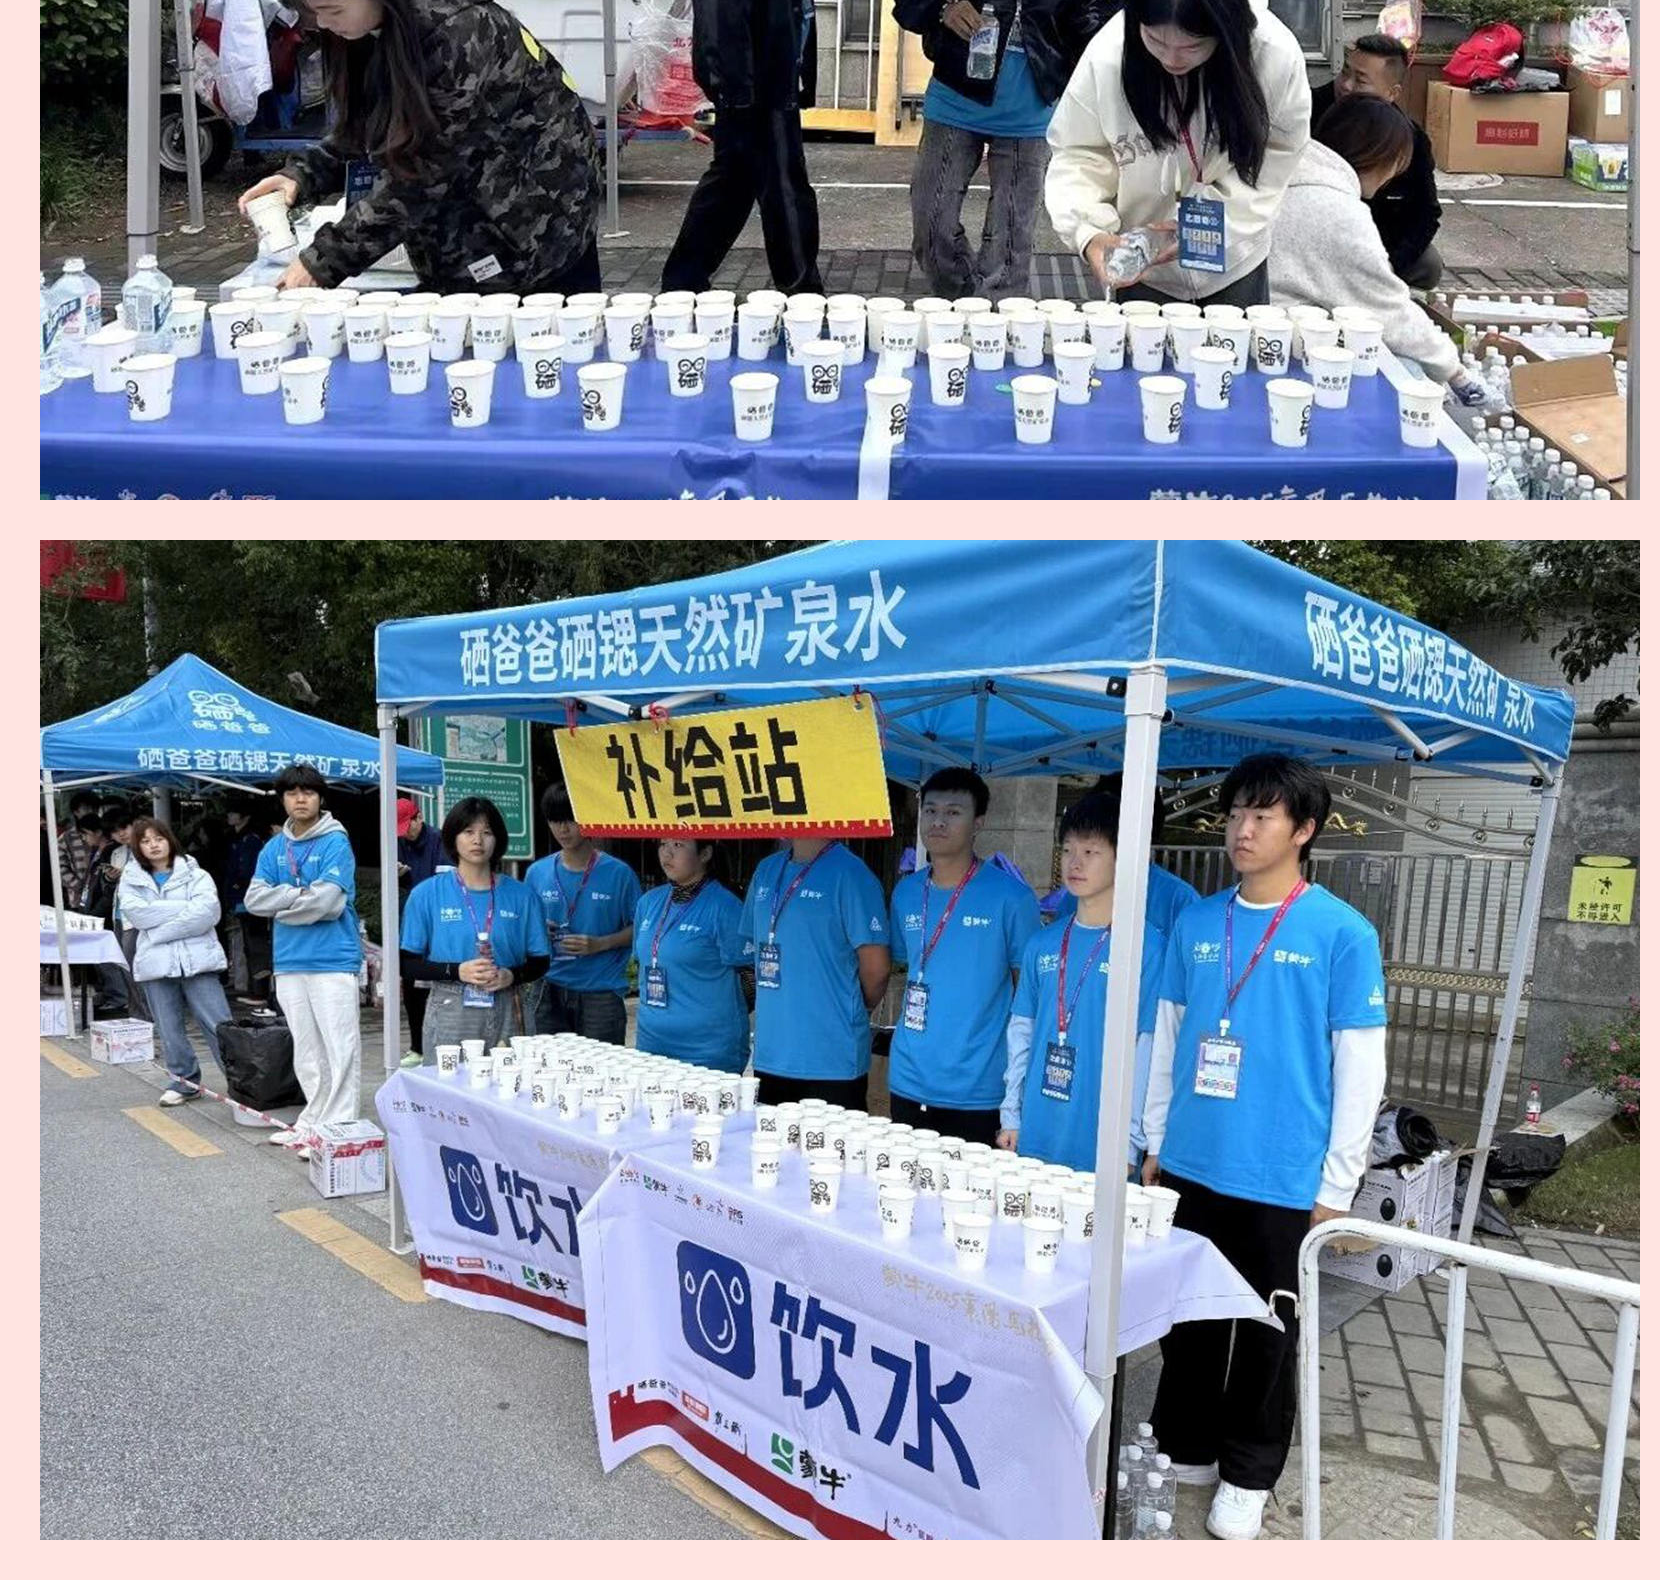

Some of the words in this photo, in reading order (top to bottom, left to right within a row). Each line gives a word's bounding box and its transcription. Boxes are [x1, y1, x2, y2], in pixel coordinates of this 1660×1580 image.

[459, 570, 906, 687] 硒爸爸硒锶天然矿泉水
[1305, 590, 1535, 734] 硒爸爸硒锶天然矿泉水
[606, 718, 807, 819] 补给站
[768, 1280, 980, 1491] 饮水
[800, 1449, 846, 1500] 蒙牛
